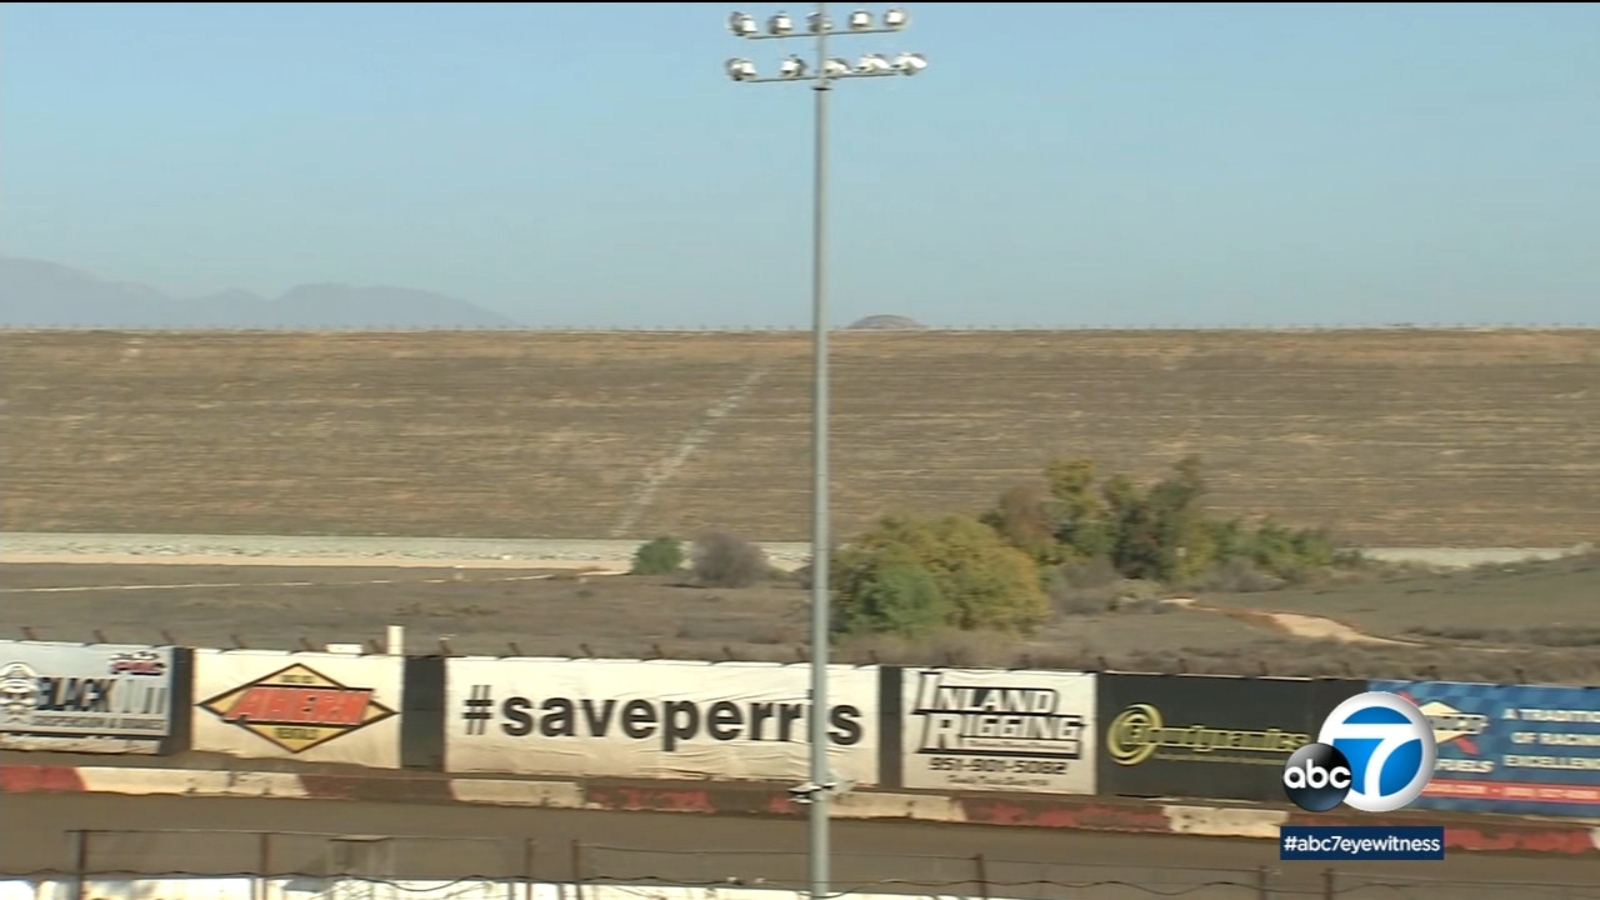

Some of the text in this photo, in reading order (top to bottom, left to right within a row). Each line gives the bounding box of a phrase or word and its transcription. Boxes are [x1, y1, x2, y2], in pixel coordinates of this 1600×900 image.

[913, 671, 1060, 714] INLAND
[915, 713, 1085, 757] RIGGING
[1511, 731, 1538, 744] OF
